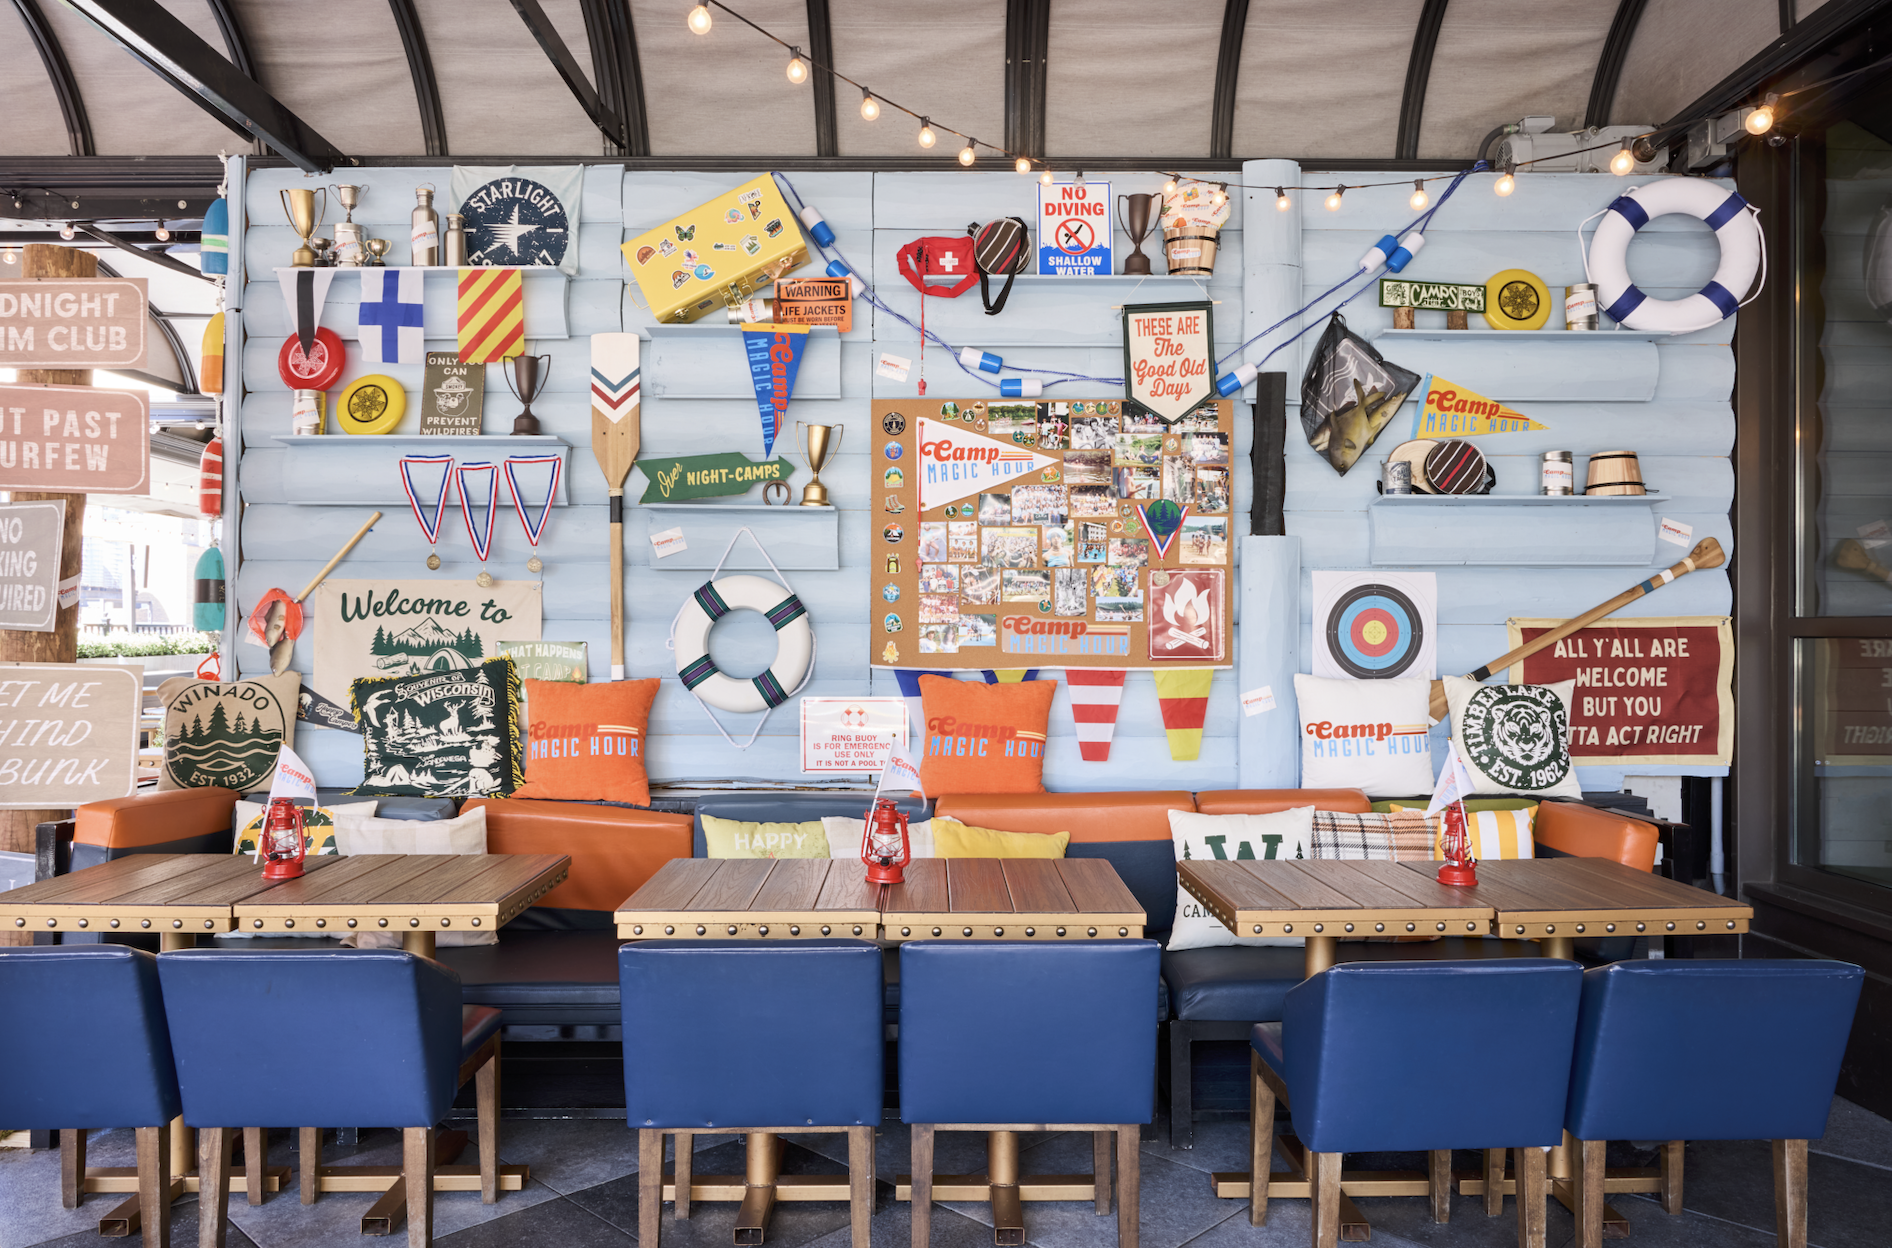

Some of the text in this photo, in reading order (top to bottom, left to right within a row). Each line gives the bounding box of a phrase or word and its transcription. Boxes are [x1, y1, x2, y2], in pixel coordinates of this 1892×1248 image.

[470, 181, 561, 218] STARLIGHT
[1062, 186, 1087, 200] NO
[1045, 202, 1105, 216] DIVING
[1048, 256, 1103, 266] SHALLOW
[1055, 266, 1095, 275] WATER
[785, 285, 841, 298] WARNING
[1410, 284, 1458, 308] CAMPS
[803, 305, 846, 316] JACKETS
[1135, 316, 1200, 337] THESE ARE
[47, 326, 127, 352] CLUB
[1154, 337, 1185, 357] The
[428, 357, 459, 366] ONLY
[443, 367, 467, 375] CAN
[770, 332, 793, 410] Camp
[1133, 358, 1207, 385] Good Old
[746, 338, 772, 391] MAGIC
[759, 403, 774, 445] HOUR
[1149, 378, 1192, 401] Days
[1426, 390, 1500, 420] Camp
[43, 408, 121, 439] PAST
[427, 417, 477, 425] PREVENT
[1425, 412, 1530, 432] MAGIC HOUR
[921, 440, 1000, 464] Camp
[657, 462, 781, 498] Over NIGHT-CAMPS
[927, 461, 1034, 484] MAGIC HOUR
[341, 588, 513, 624] Welcome to
[1003, 616, 1088, 640] Camp
[535, 643, 583, 660] HAPPENS
[1010, 634, 1129, 654] MAGIC HOUR
[1554, 638, 1588, 658] ALL
[1650, 637, 1690, 658] ARE
[534, 662, 572, 681] CAMP
[1576, 667, 1668, 687] WELCOME
[37, 682, 102, 708] ME
[173, 685, 269, 714] WINADO
[1583, 696, 1661, 716] BUT YOU
[529, 721, 598, 742] Camp
[928, 715, 1016, 744] Camp
[1306, 721, 1393, 741] Camp
[1466, 685, 1556, 758] TIMBER LAKE
[831, 734, 877, 742] RING BUOY
[1313, 734, 1430, 757] MAGIC HOUR
[1568, 725, 1703, 746] TTA ACT RIGHT
[531, 736, 639, 760] MAGIC HOUR
[929, 736, 988, 757] MAGIC
[223, 767, 255, 786] 1932
[1488, 759, 1522, 787] EST.
[1530, 761, 1563, 787] 1962
[734, 832, 808, 850] HAPPY
[1183, 904, 1214, 918] CAM
